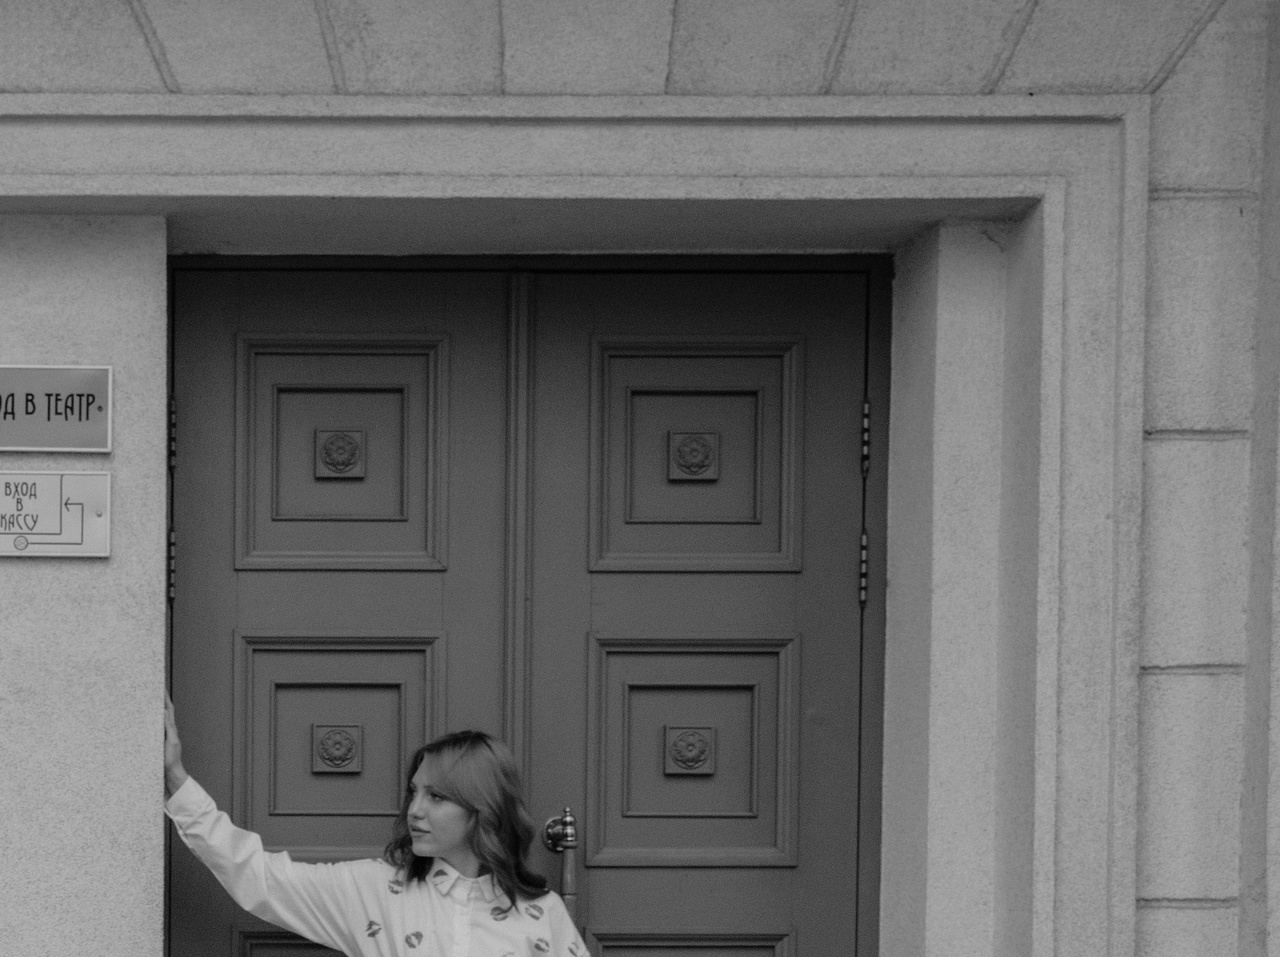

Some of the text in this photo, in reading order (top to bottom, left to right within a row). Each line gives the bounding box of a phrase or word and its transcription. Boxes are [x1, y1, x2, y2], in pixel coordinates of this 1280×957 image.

[25, 393, 36, 415] В
[45, 393, 96, 422] ТЕАТР
[4, 482, 37, 500] ВХОД
[16, 498, 24, 512] В
[0, 514, 39, 531] КАССУ
